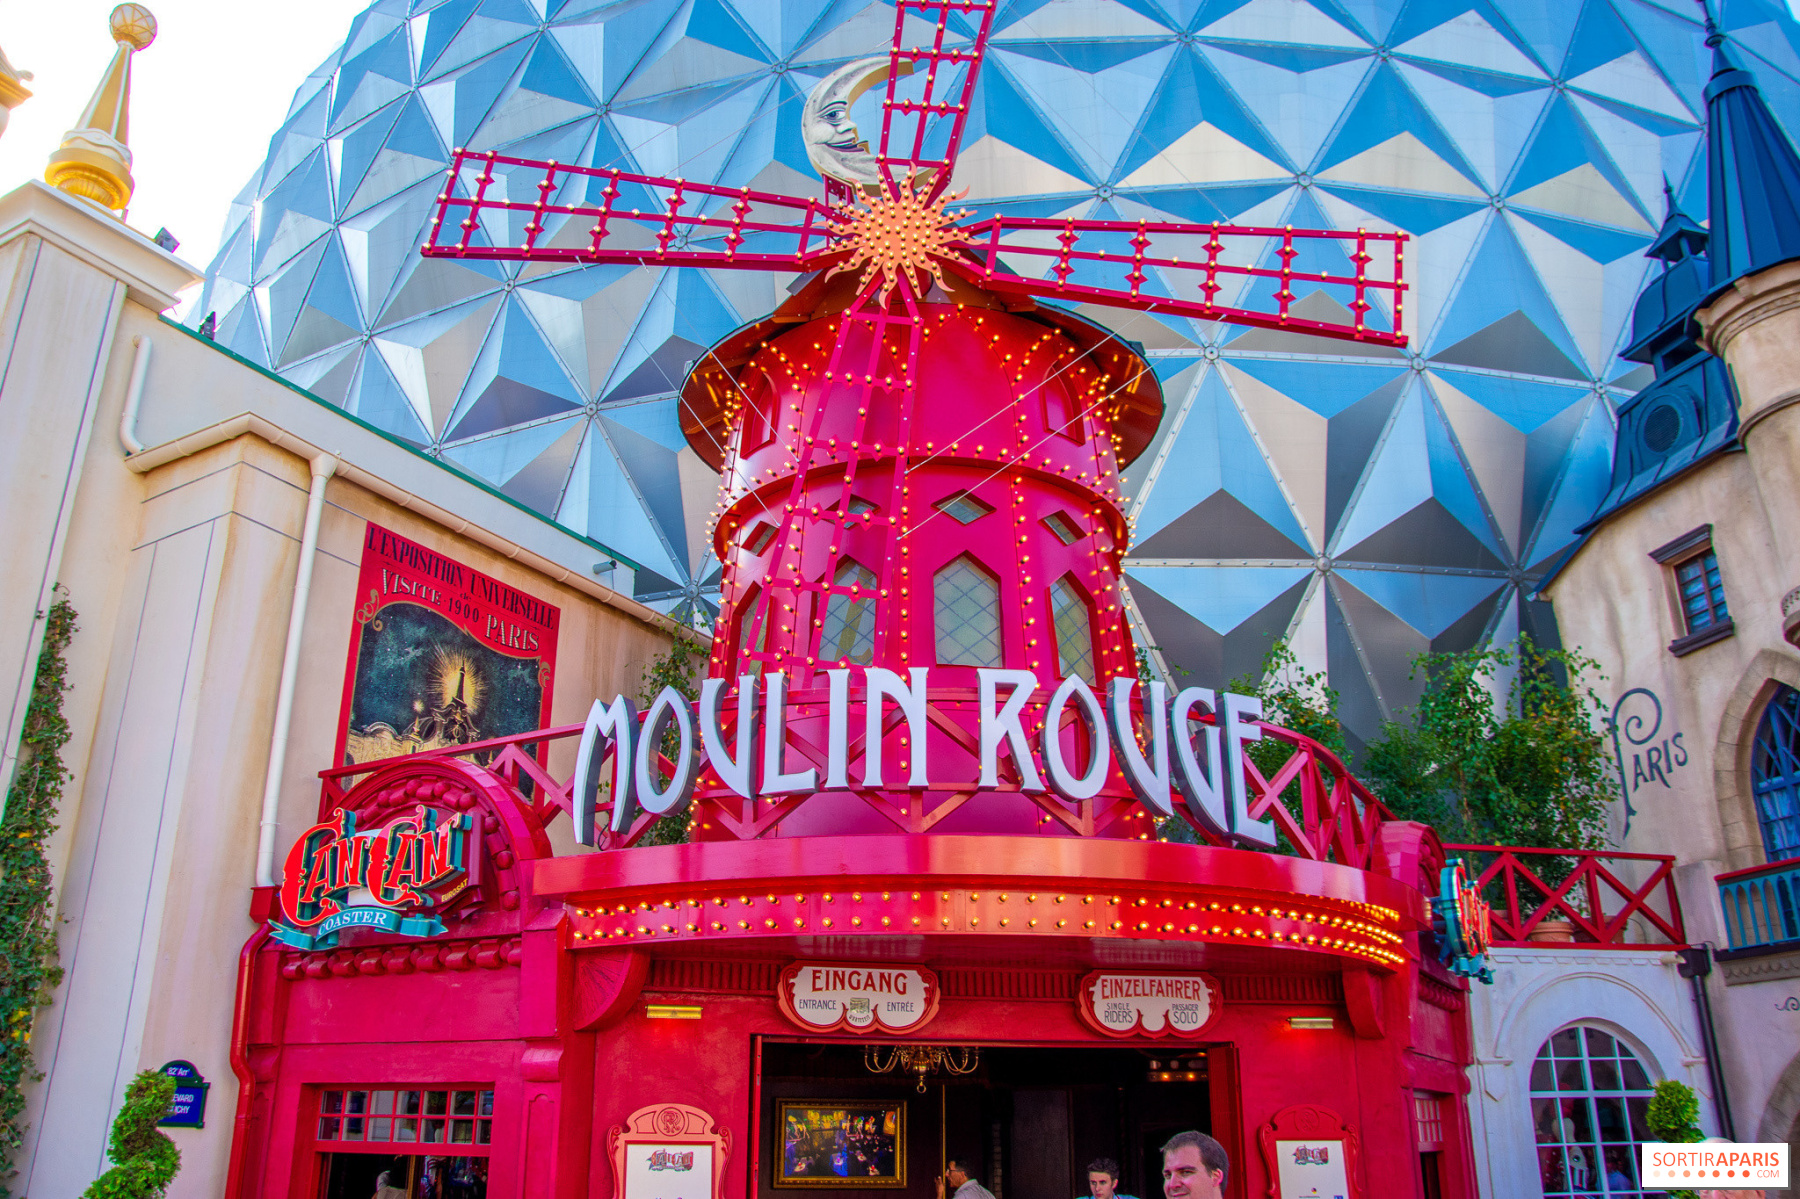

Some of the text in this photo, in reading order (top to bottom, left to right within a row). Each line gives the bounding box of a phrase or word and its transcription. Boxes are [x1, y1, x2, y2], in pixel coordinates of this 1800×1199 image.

[367, 526, 555, 630] L'EXPOSITION UNIVERSELLE
[381, 567, 540, 652] VISITE 1900 PARIS
[572, 666, 1277, 847] MOULIN ROUGE
[1602, 687, 1689, 840] PARIS
[441, 878, 469, 903] EUROSAT
[318, 910, 387, 937] COASTER
[811, 969, 908, 996] EINGANG
[1101, 978, 1201, 1001] EINZELFAHRER
[798, 998, 837, 1011] ENTRANCE
[886, 1001, 915, 1013] ENTRÉE
[1106, 1002, 1130, 1011] SINGLE
[1172, 1003, 1199, 1012] PASSAGER
[1104, 1010, 1133, 1024] RIDERS
[1173, 1011, 1199, 1024] SOLO
